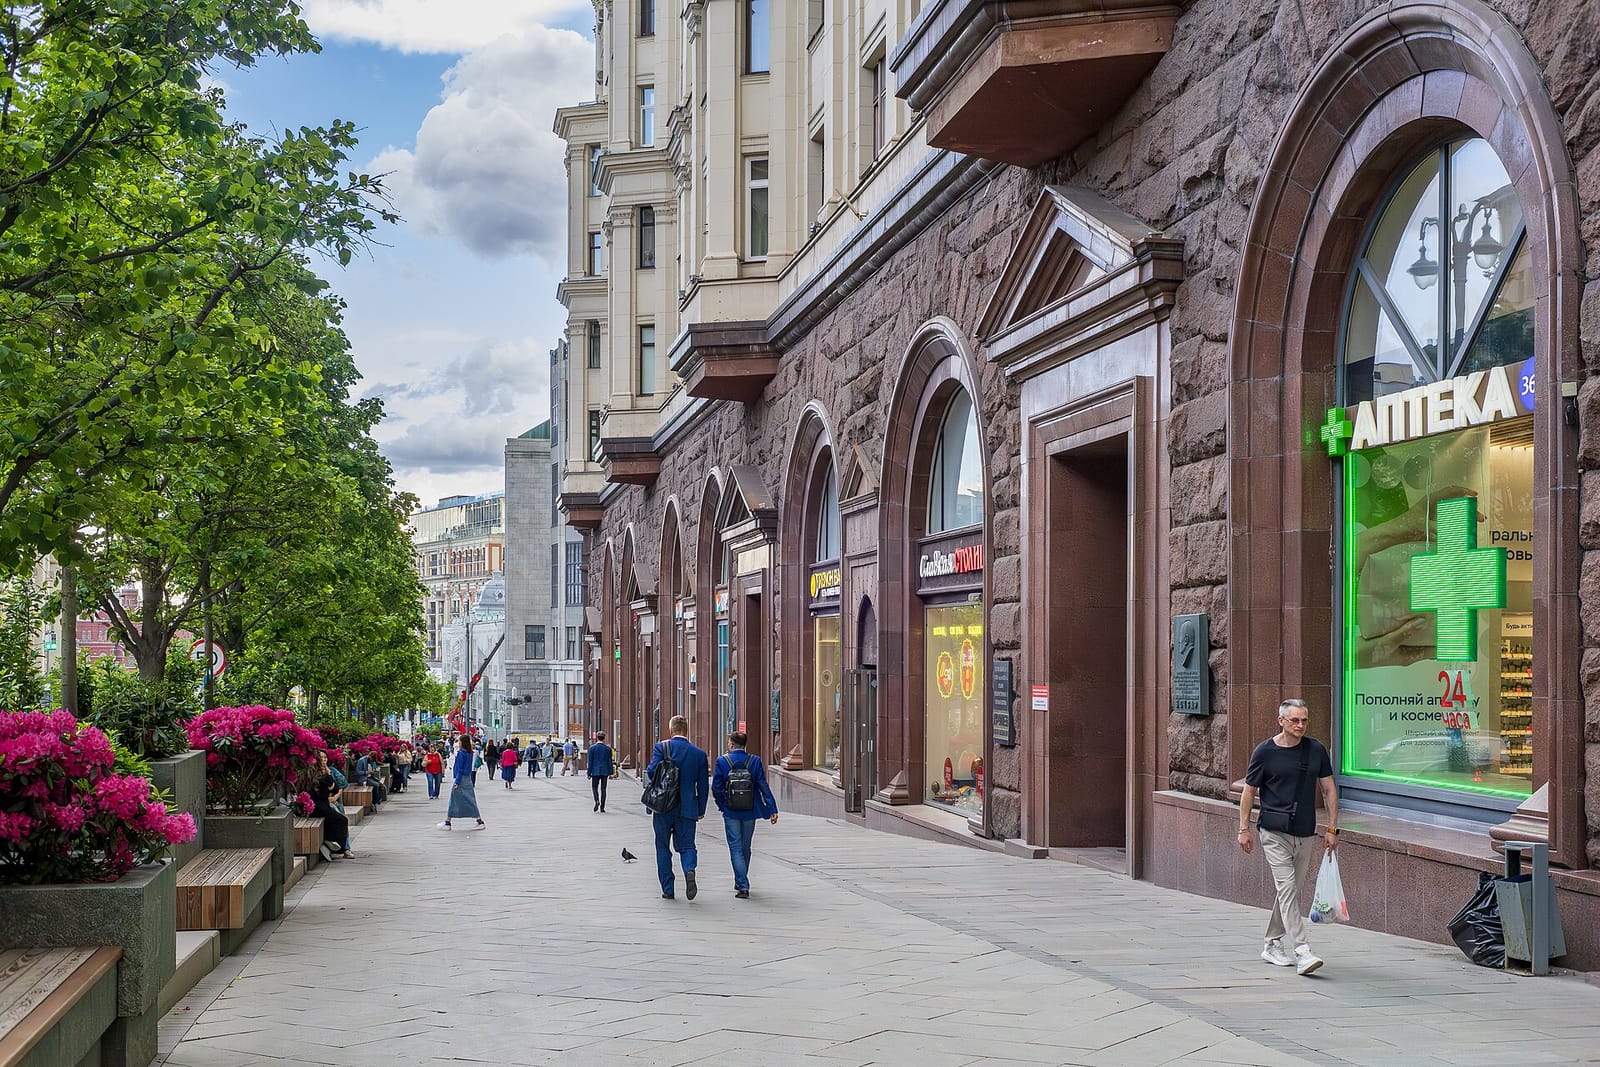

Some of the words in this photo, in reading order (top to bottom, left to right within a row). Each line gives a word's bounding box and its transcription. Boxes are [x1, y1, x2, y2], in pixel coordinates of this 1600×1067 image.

[1350, 366, 1518, 450] АПТЕКА
[1489, 530, 1534, 545] ральн
[1438, 670, 1467, 708] 24
[1355, 693, 1423, 705] Пополняй
[1389, 712, 1398, 721] и
[1441, 711, 1471, 730] часа
